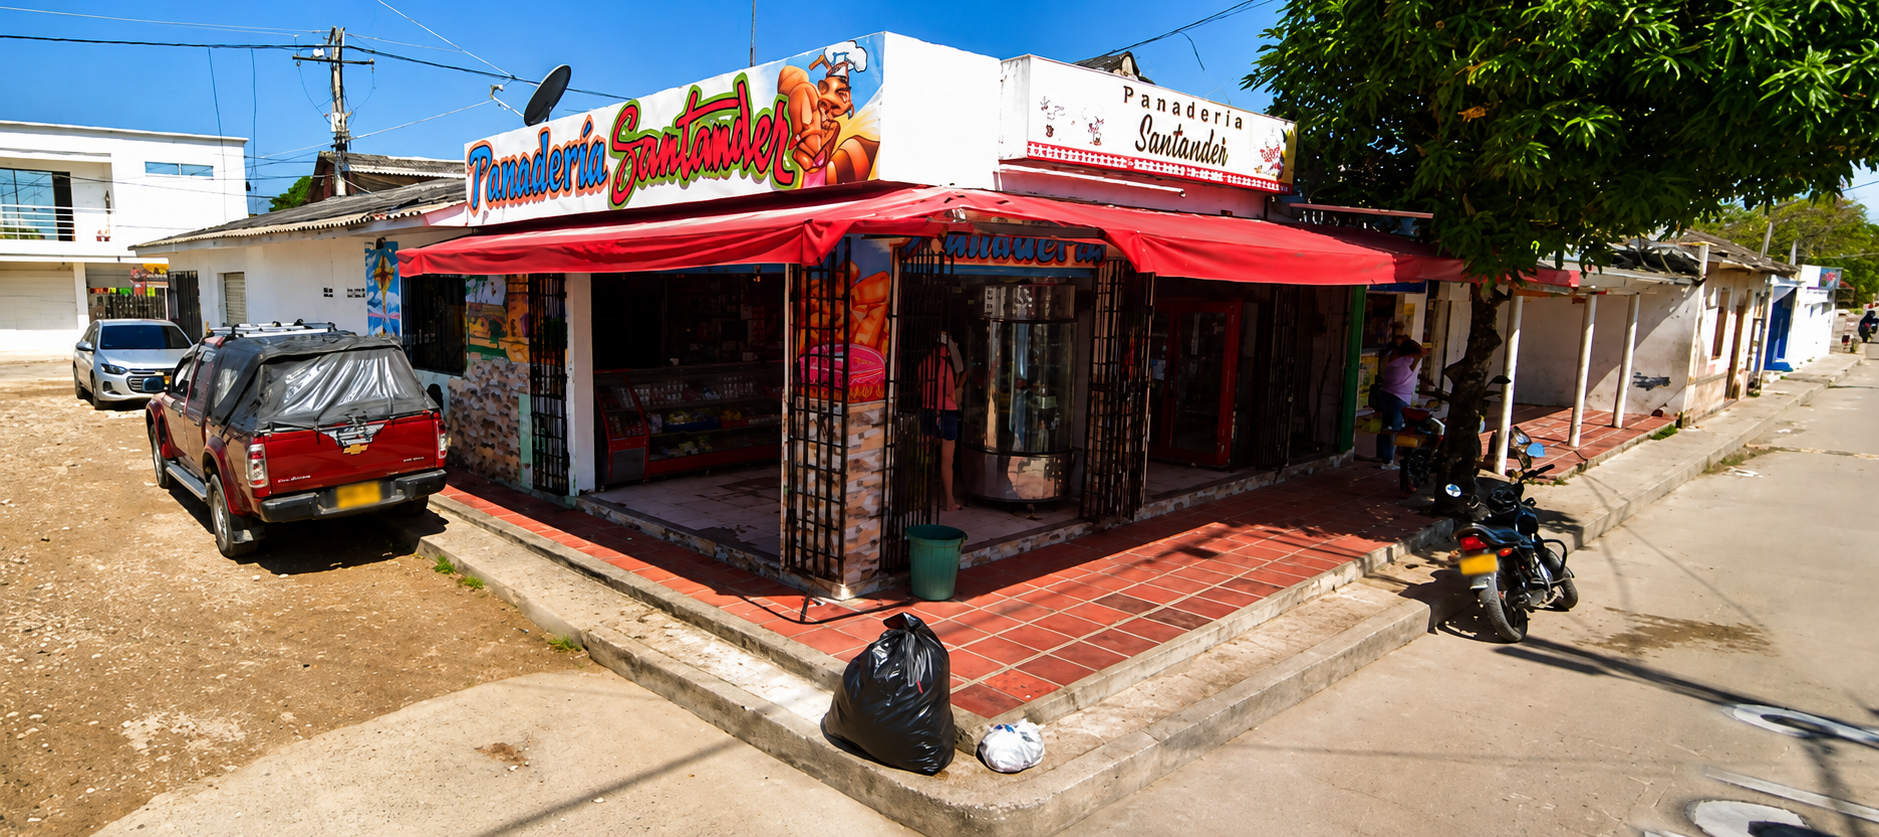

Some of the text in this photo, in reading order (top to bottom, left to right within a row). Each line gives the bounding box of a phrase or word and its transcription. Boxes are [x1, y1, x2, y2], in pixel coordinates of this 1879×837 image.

[1123, 85, 1243, 130] Panaderia
[468, 74, 800, 216] Panadería Santander
[1135, 113, 1228, 167] Santander
